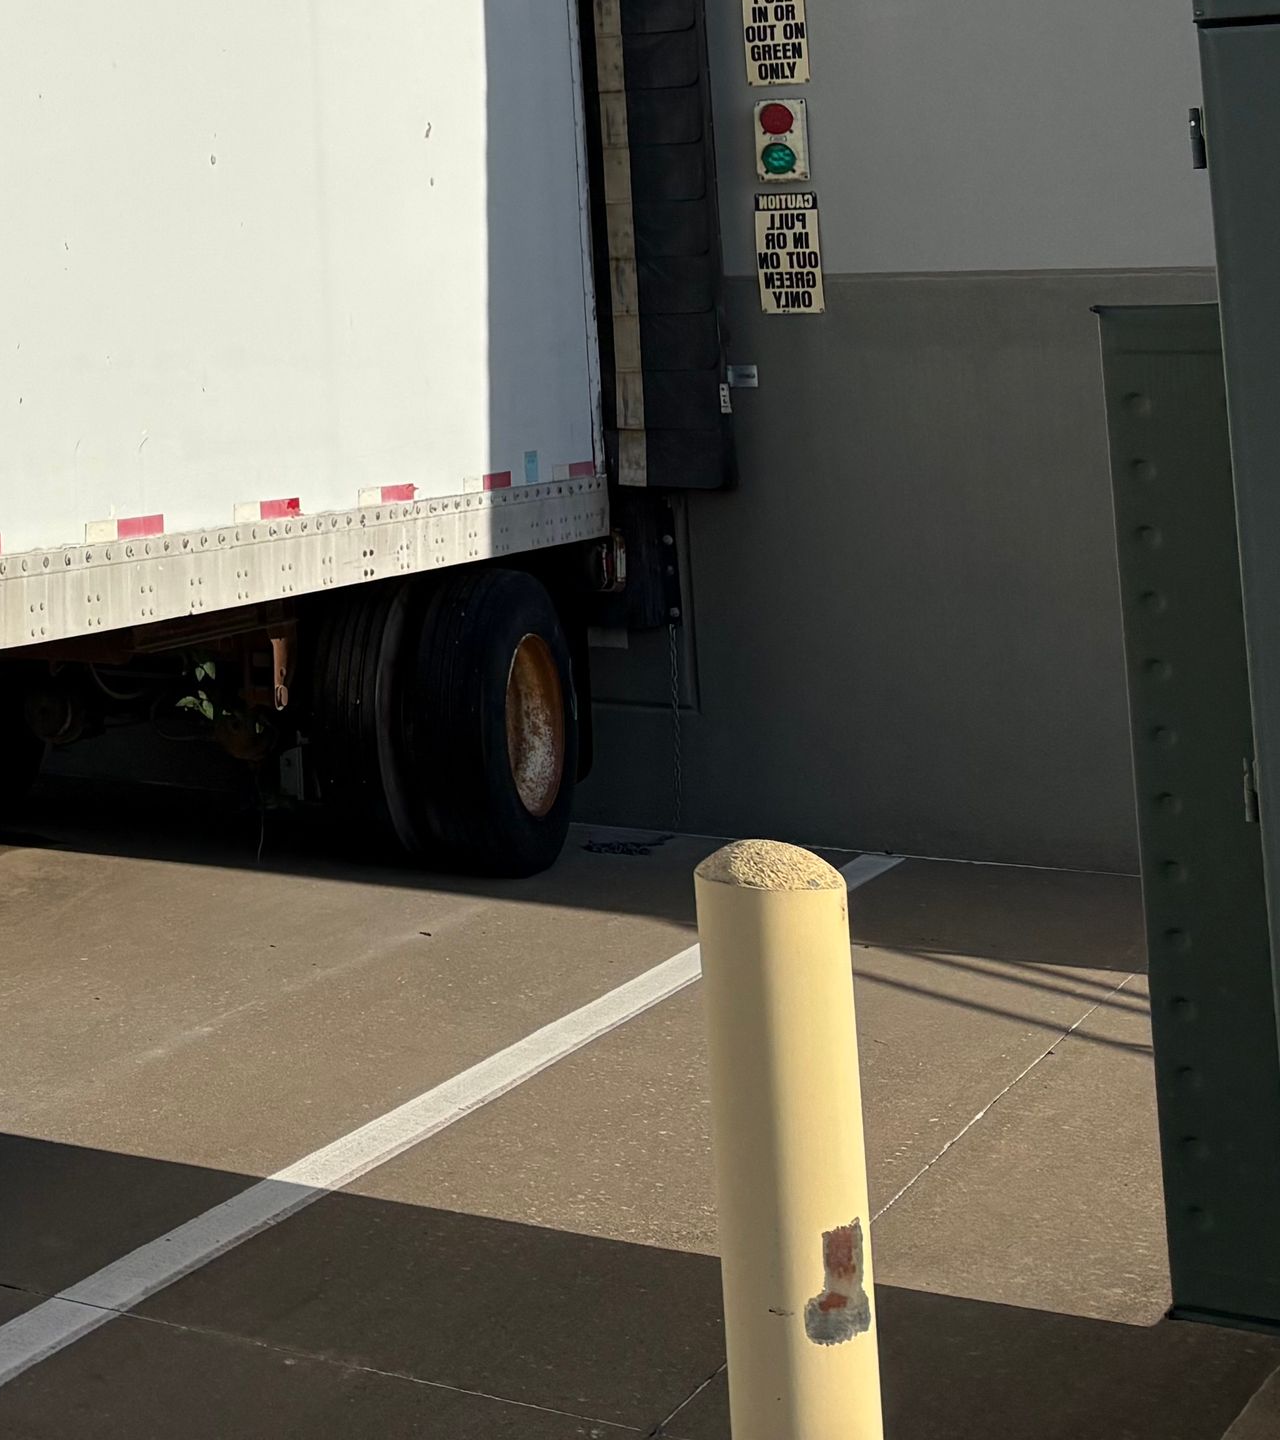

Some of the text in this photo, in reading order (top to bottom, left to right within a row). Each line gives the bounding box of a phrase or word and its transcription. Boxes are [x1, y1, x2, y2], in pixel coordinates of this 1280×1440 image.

[752, 4, 795, 23] IN OR
[745, 22, 805, 43] OUT ON
[751, 42, 802, 61] GREEN
[758, 62, 796, 80] ONLY
